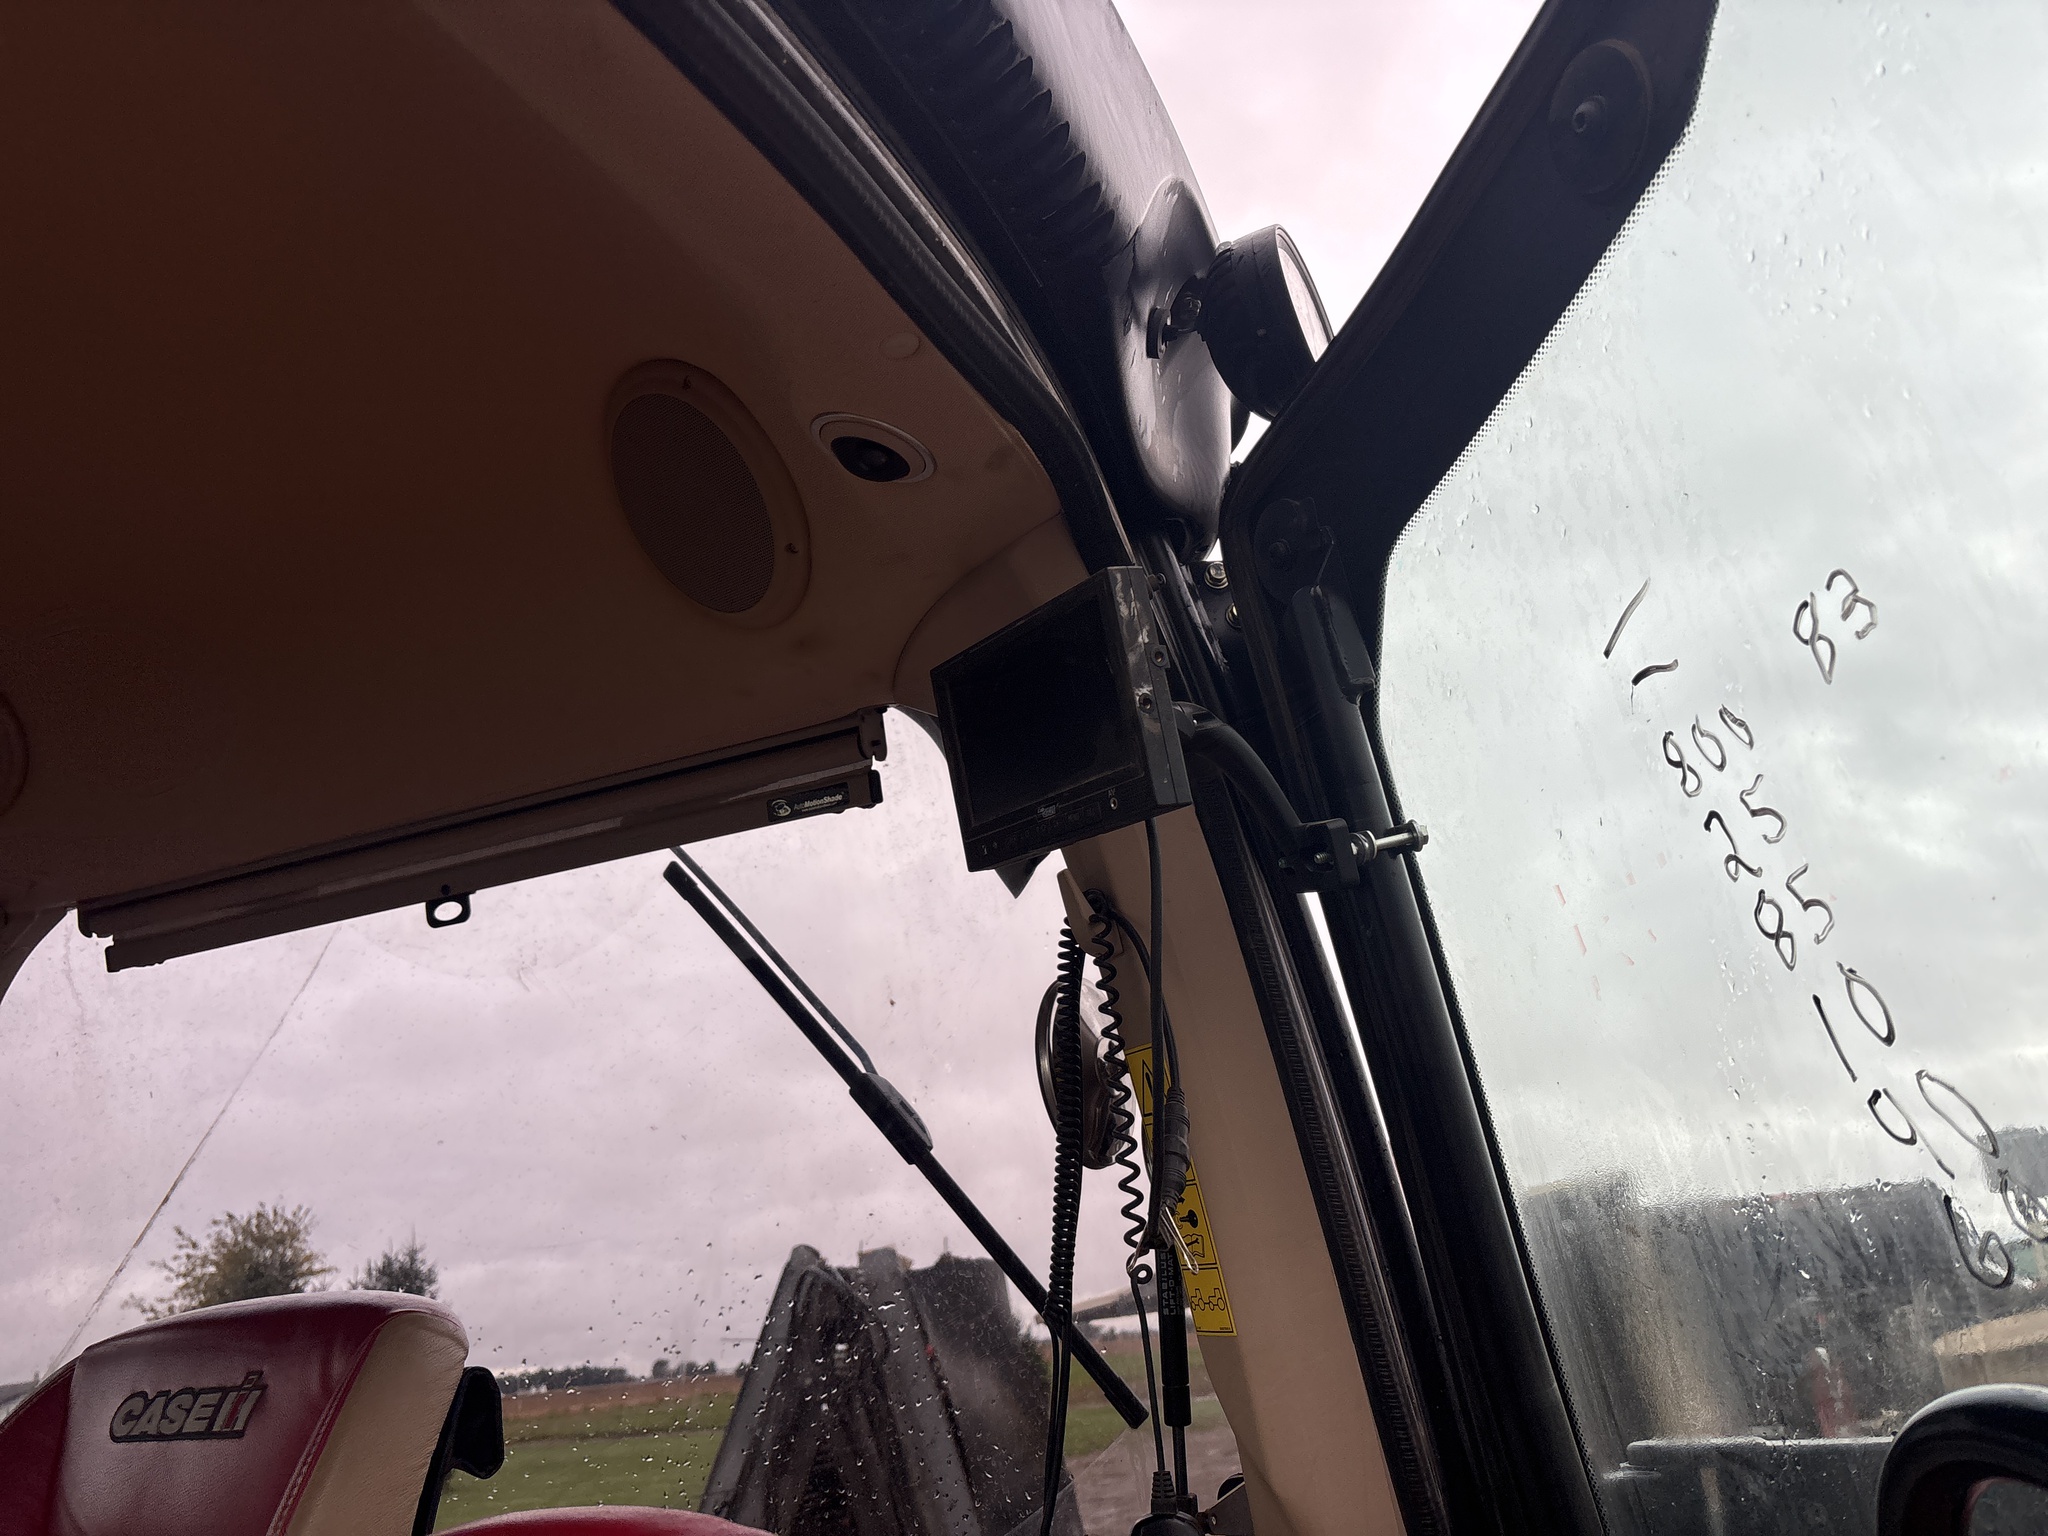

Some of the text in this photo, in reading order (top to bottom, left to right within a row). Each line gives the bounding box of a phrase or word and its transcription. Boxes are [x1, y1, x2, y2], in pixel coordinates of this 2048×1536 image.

[1793, 568, 1878, 685] 83
[1662, 703, 1754, 798] 800
[1703, 773, 1788, 883] 25
[1754, 863, 1835, 972] 85
[1812, 961, 1896, 1083] 10
[1867, 1069, 2000, 1180] 90
[1161, 1253, 1169, 1315] STABILUS
